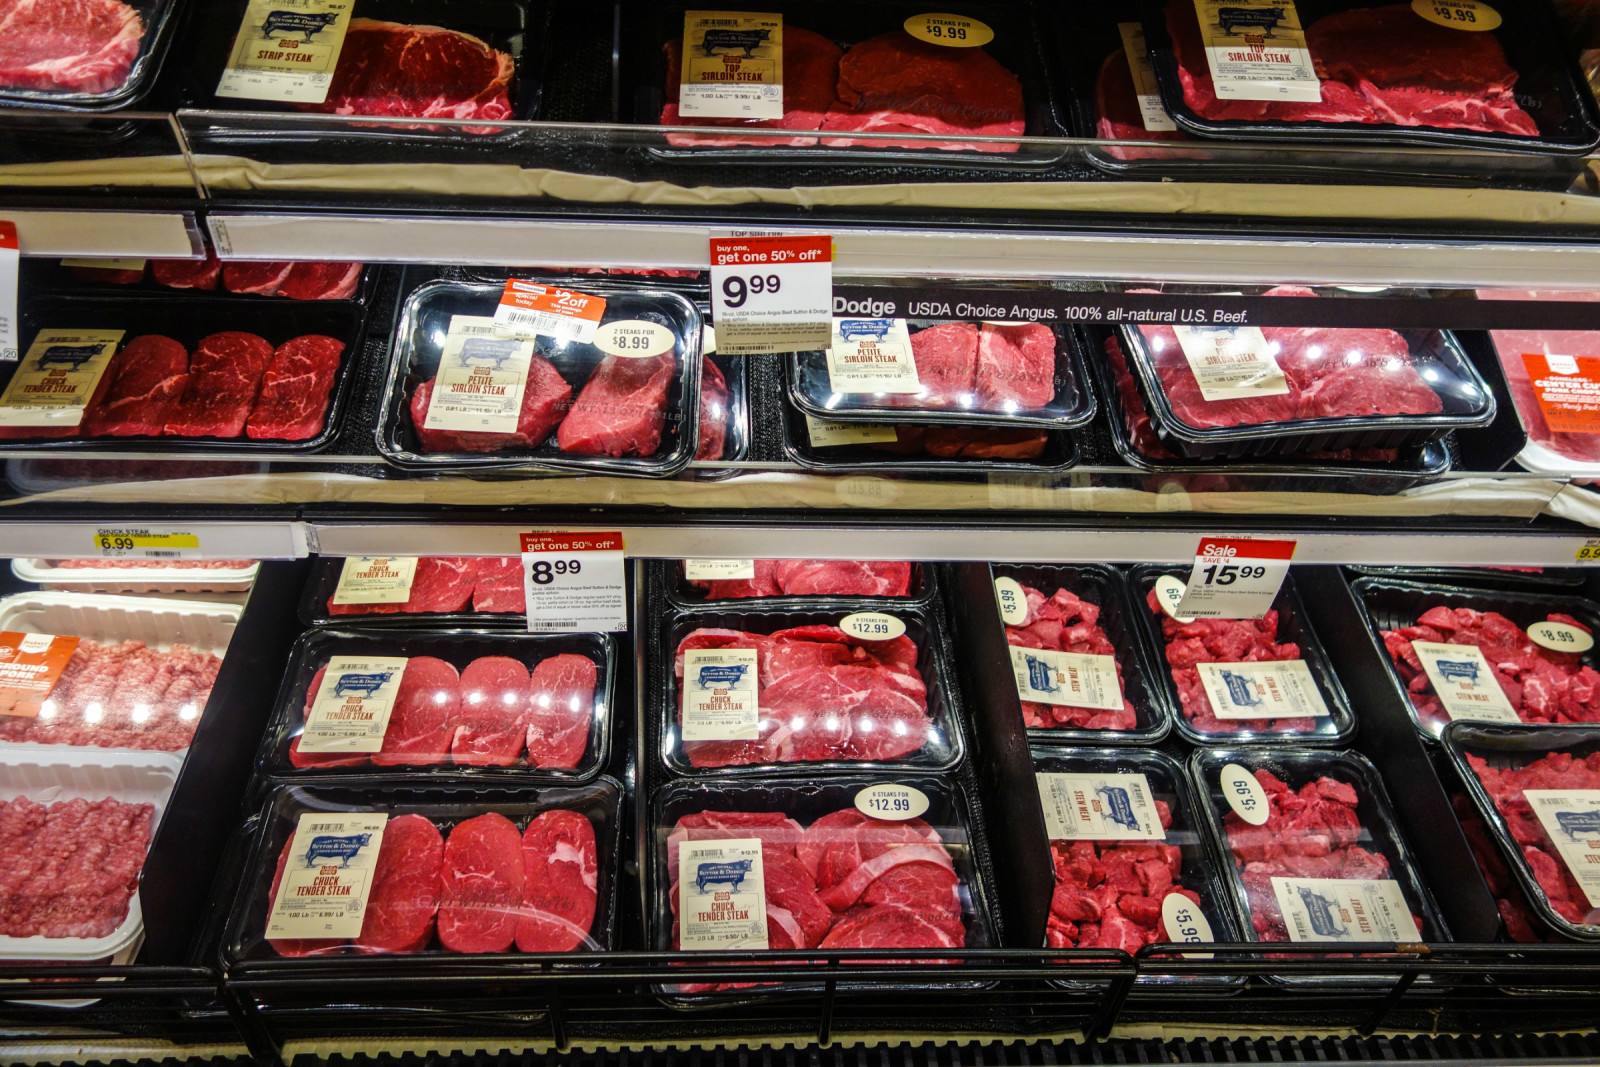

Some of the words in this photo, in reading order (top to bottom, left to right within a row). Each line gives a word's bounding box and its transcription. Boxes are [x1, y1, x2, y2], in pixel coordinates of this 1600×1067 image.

[1434, 7, 1476, 23] $9.99
[926, 25, 967, 40] $9.99
[1248, 44, 1266, 54] TOP
[257, 50, 283, 60] STRIP
[285, 52, 314, 62] STEAK
[1228, 52, 1262, 62] SIRLOIN
[1265, 54, 1292, 64] STEAK
[725, 64, 740, 72] TOP
[702, 72, 734, 80] SIRLOIN
[737, 72, 763, 82] STEAK
[718, 252, 740, 265] get
[742, 252, 768, 262] one
[770, 250, 796, 261] 50%
[515, 298, 534, 306] today
[832, 296, 896, 318] Dodge
[908, 302, 952, 316] USDA
[955, 303, 1007, 318] Choice
[1009, 305, 1058, 321] Angus.
[1064, 306, 1102, 320] 100%
[1106, 308, 1177, 322] all-natural
[1180, 309, 1208, 322] U.S.
[1212, 310, 1248, 323] Beef.
[613, 336, 650, 350] $8.99
[858, 348, 880, 356] PETITE
[41, 378, 67, 386] CHUCK
[468, 376, 494, 385] PETITE
[1534, 380, 1581, 388] CENTER
[23, 384, 52, 393] TENDER
[52, 385, 78, 393] STEAK
[451, 384, 480, 394] SIRLOIN
[482, 386, 506, 396] STEAK
[552, 403, 573, 411] NET
[101, 538, 134, 550] 6.99
[527, 542, 546, 552] get
[572, 541, 592, 549] 50%
[1203, 544, 1237, 557] Sale
[1000, 590, 1016, 614] $5.99
[853, 623, 888, 634] $12.99
[1540, 630, 1575, 643] $8.99
[0, 670, 36, 679] PORK
[1068, 666, 1078, 680] MEAT
[1071, 680, 1080, 692] STEW
[1264, 676, 1277, 688] MEAT
[710, 696, 731, 704] CHUCK
[1456, 692, 1472, 700] STEW
[340, 704, 364, 712] CHUCK
[326, 712, 351, 720] TENDER
[352, 712, 374, 720] STEAK
[1074, 790, 1087, 806] STEW
[1233, 780, 1256, 811] $5.99
[869, 799, 910, 811] $12.99
[1078, 806, 1091, 821] MEAT
[314, 876, 340, 886] CHUCK
[297, 886, 325, 896] TENDER
[327, 886, 351, 896] STEAK
[711, 902, 735, 911] CHUCK
[1350, 898, 1365, 914] MEAT
[698, 912, 725, 922] TENDER
[727, 910, 749, 920] STEAK
[1357, 917, 1372, 934] STEW
